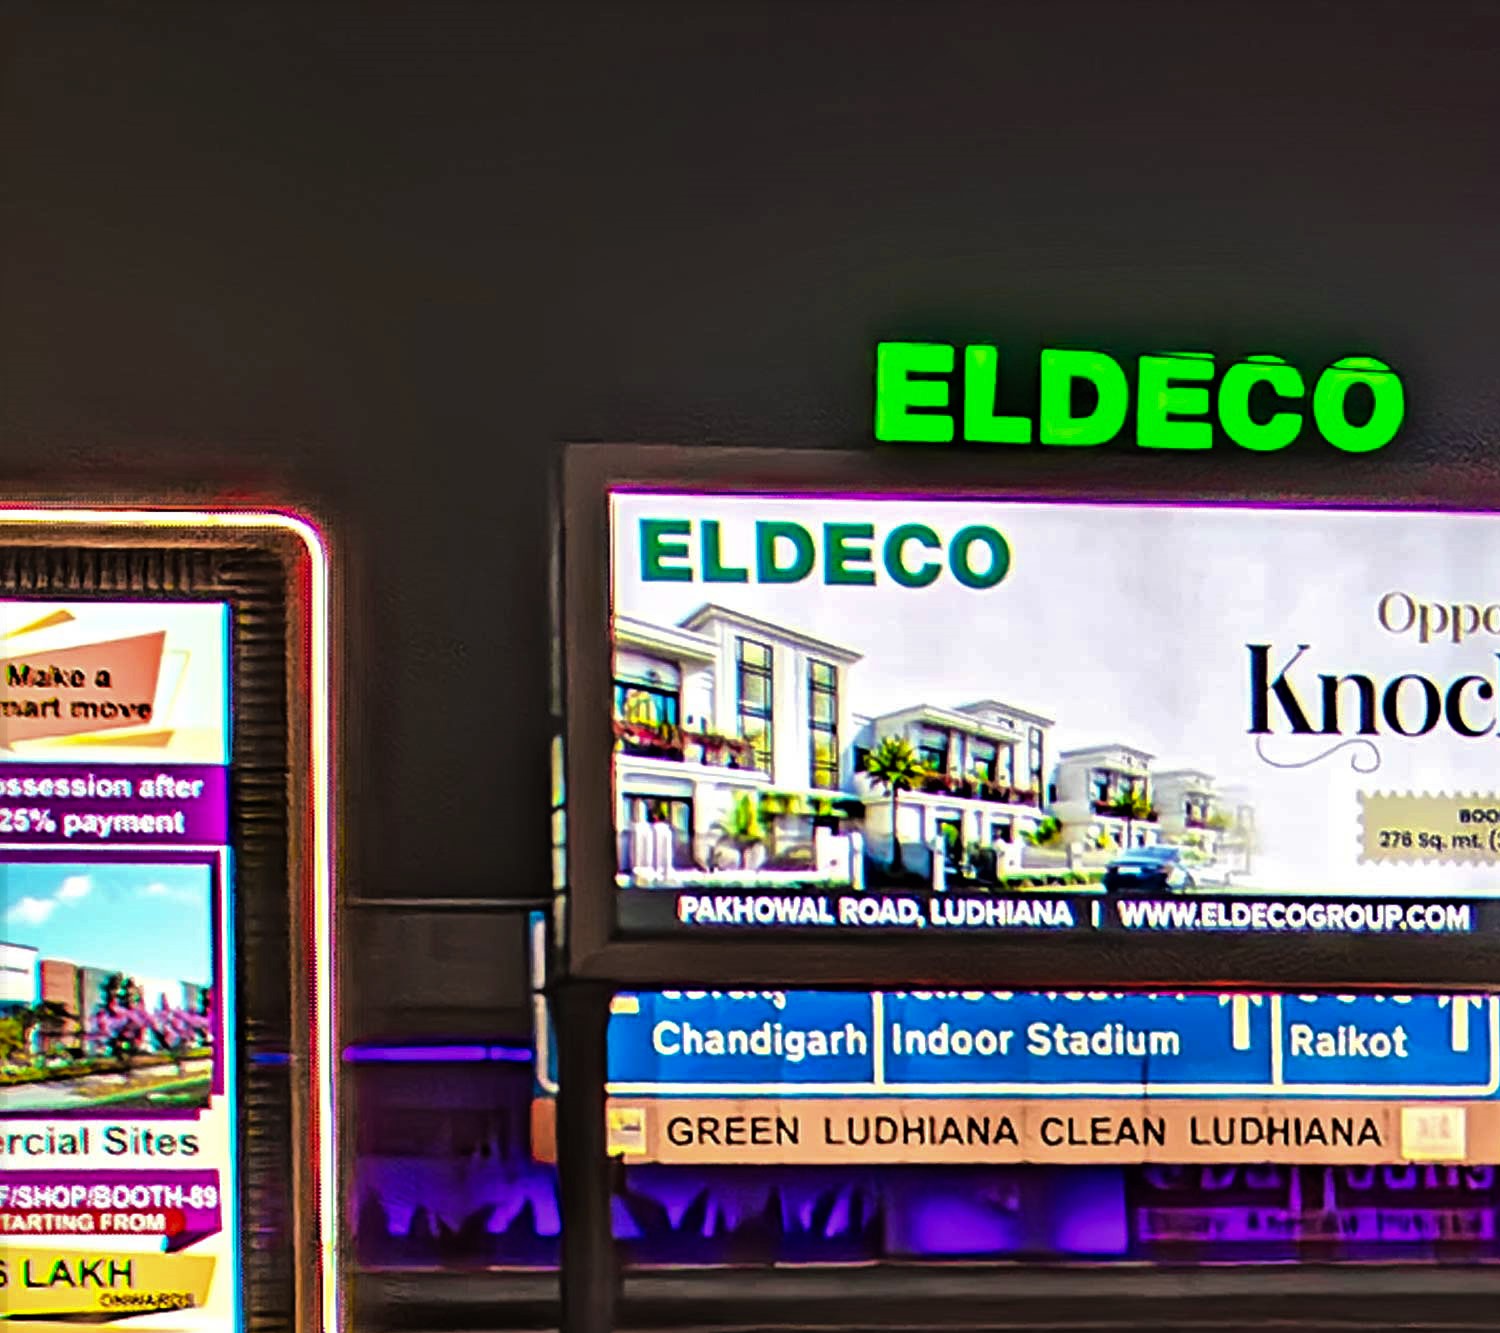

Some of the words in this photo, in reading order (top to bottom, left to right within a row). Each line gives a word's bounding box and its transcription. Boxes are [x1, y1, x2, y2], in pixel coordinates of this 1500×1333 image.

[875, 341, 1405, 453] ELDECO
[637, 517, 1012, 590] ELDECO
[7, 664, 86, 688] Make
[94, 668, 113, 688] a
[71, 701, 153, 719] move
[0, 773, 132, 798] ssession
[138, 773, 205, 799] after
[63, 811, 186, 838] payment
[1417, 831, 1448, 852] Sq.
[677, 893, 835, 926] PAKHOWAL
[838, 897, 927, 928] ROAD,
[930, 899, 1073, 927] LUDHIANA
[1117, 900, 1471, 932] WWW.ELDECOGROUP.COM
[652, 1020, 868, 1063] Chandigarh
[892, 1023, 1014, 1056] Indoor
[1026, 1023, 1180, 1057] Stadium
[1290, 1024, 1409, 1058] Raikot
[0, 1127, 89, 1156] rcial
[104, 1126, 200, 1156] Sites
[667, 1116, 800, 1146] GREEN
[824, 1117, 1020, 1146] LUDHIANA
[1040, 1116, 1166, 1147] CLEAN
[1190, 1117, 1382, 1147] LUDHIANA
[99, 1213, 167, 1232] FROM
[24, 1259, 134, 1288] LAKH
